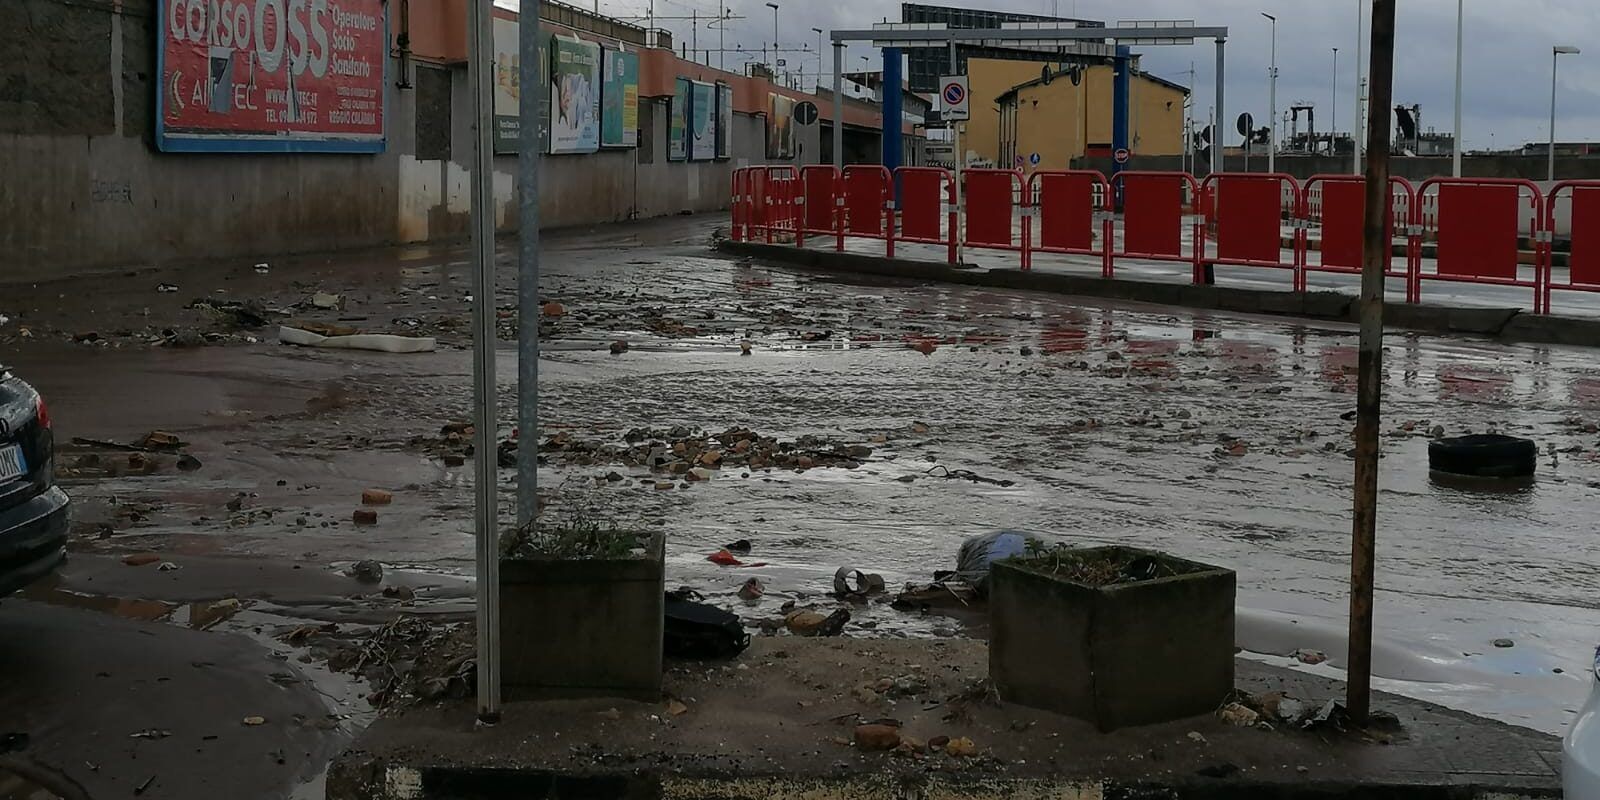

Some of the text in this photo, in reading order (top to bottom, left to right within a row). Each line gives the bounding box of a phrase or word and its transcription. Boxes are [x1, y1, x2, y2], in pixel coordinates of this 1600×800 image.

[332, 4, 376, 32] Operatore
[170, 0, 328, 78] CORSO OSS
[332, 29, 355, 51] Socio
[332, 52, 370, 77] Sanitario
[329, 110, 376, 125] REGGIO CALABRIA
